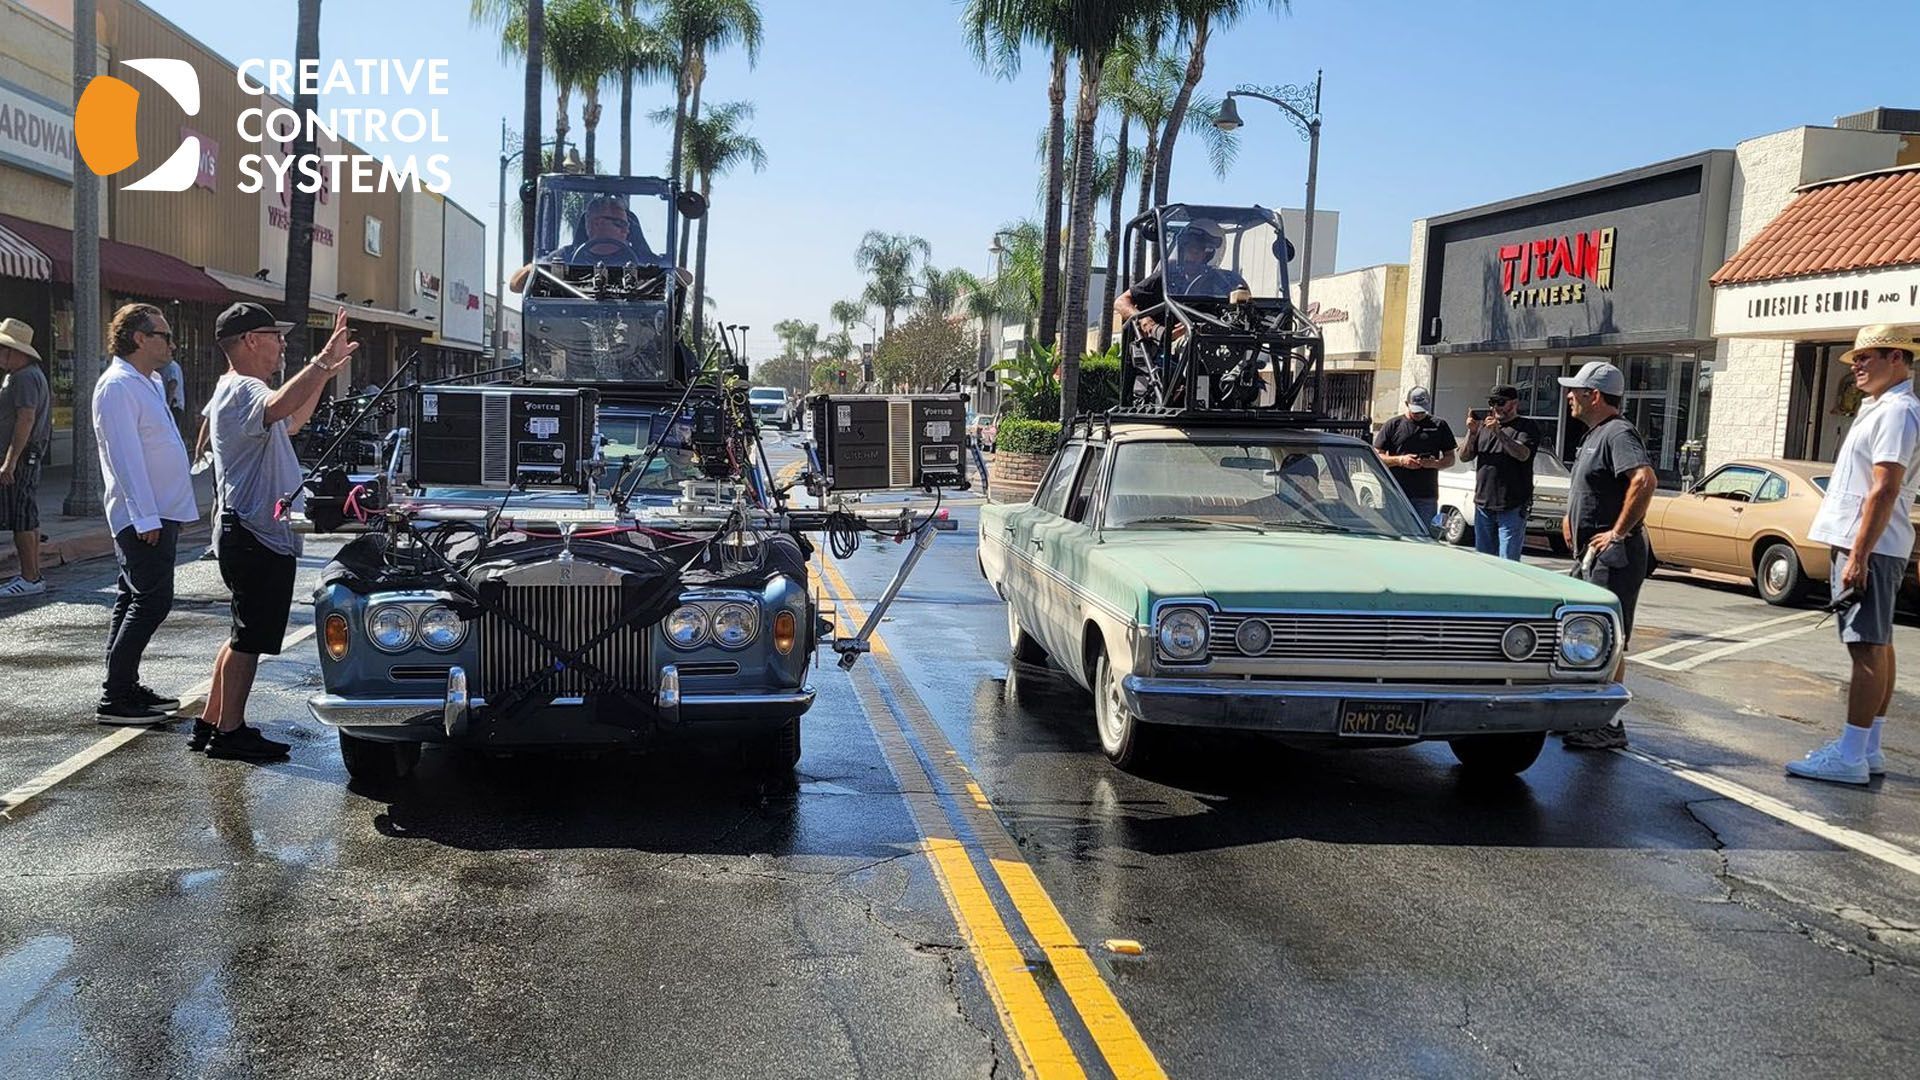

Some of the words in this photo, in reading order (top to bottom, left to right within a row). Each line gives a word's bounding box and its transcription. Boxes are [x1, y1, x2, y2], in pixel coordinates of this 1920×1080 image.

[1499, 229, 1600, 296] TITAN
[1510, 283, 1585, 308] FITNESS
[1815, 289, 1869, 314] SEWING
[1878, 293, 1901, 304] AND
[1344, 711, 1381, 732] RMY
[1385, 713, 1416, 732] 844
